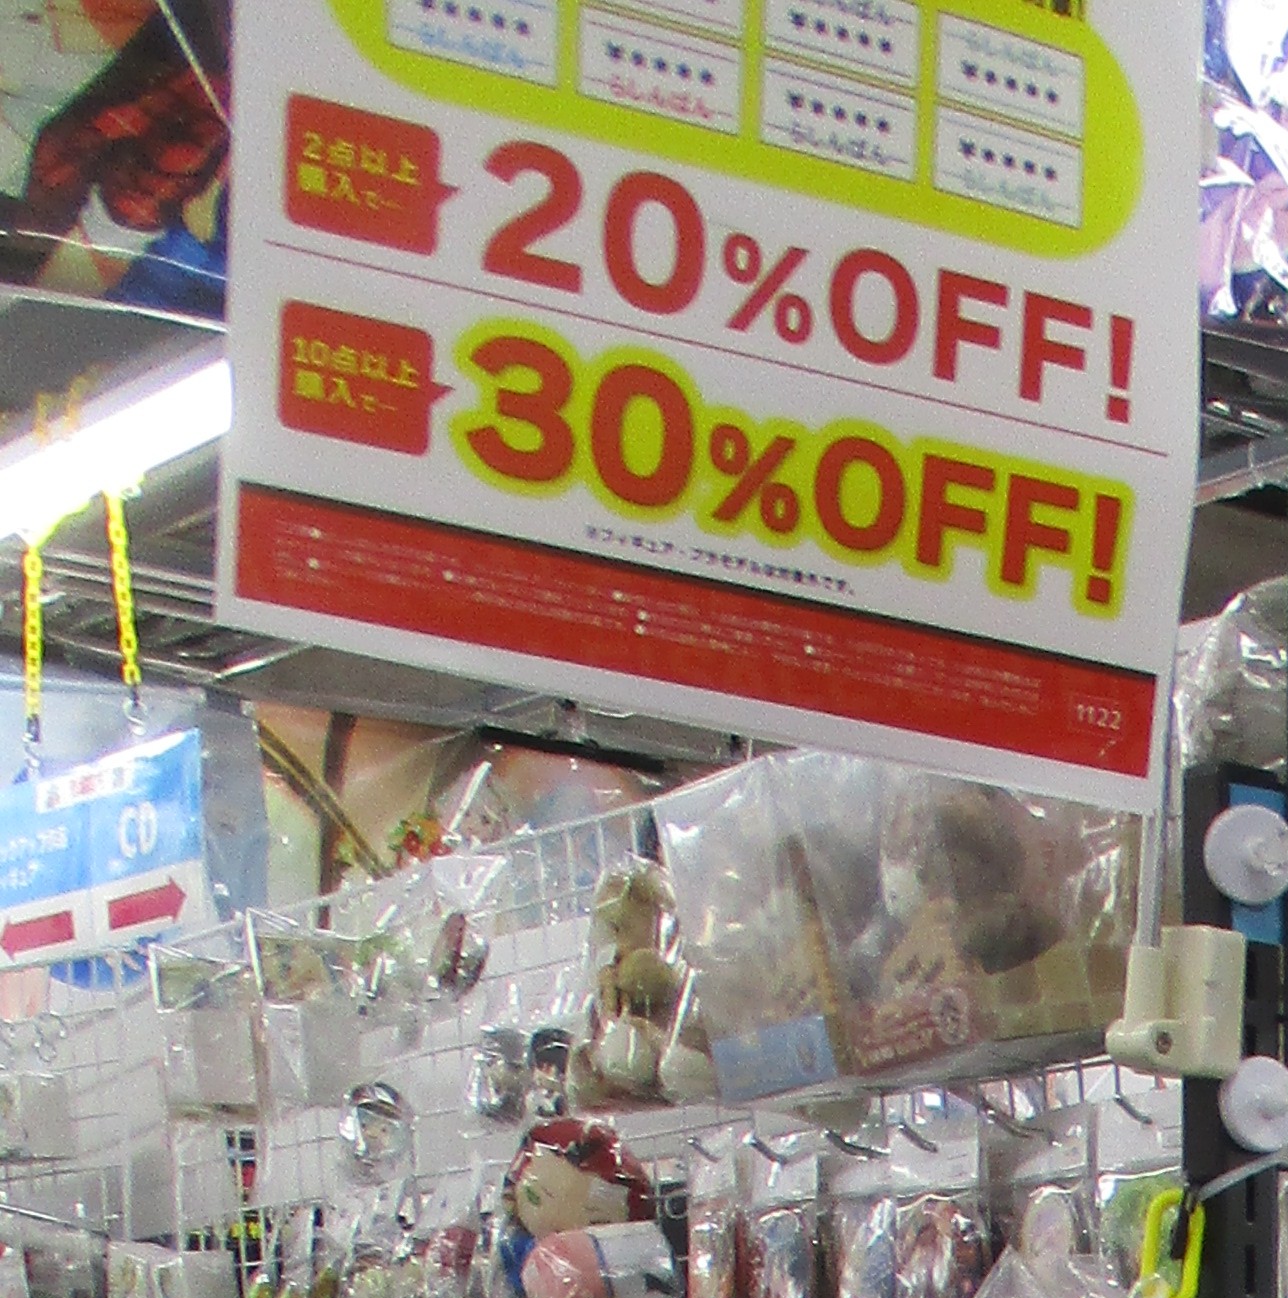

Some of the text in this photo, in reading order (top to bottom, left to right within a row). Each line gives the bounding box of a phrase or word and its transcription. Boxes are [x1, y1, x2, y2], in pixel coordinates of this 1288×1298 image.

[303, 131, 421, 187] 2点以上
[483, 140, 1134, 424] 20%OFF!
[291, 336, 419, 388] 10点以上
[466, 335, 1122, 605] 30%OFF!
[1074, 701, 1123, 732] 1122
